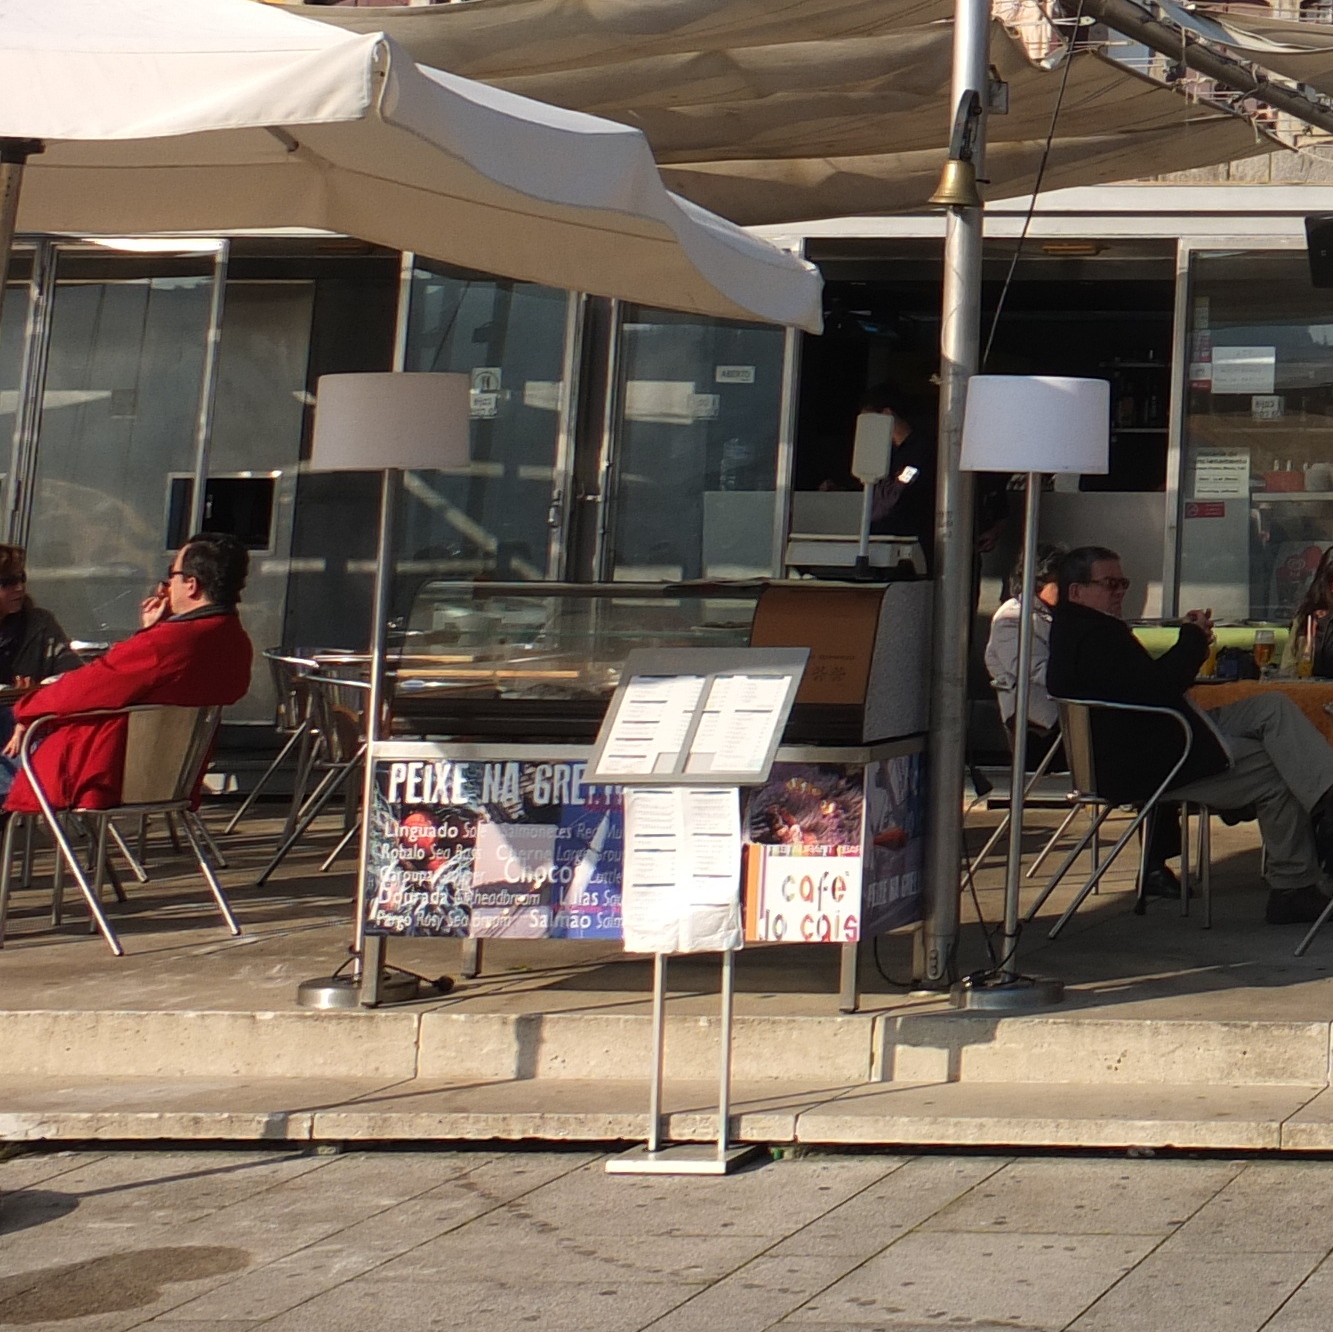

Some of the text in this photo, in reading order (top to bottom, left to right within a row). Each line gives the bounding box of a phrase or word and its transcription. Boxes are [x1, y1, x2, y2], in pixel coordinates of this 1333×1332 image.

[388, 762, 470, 804] PEIXE
[481, 761, 520, 805] NA
[384, 823, 459, 843] Linguado
[381, 846, 425, 860] Robalo
[800, 910, 859, 942] cais
